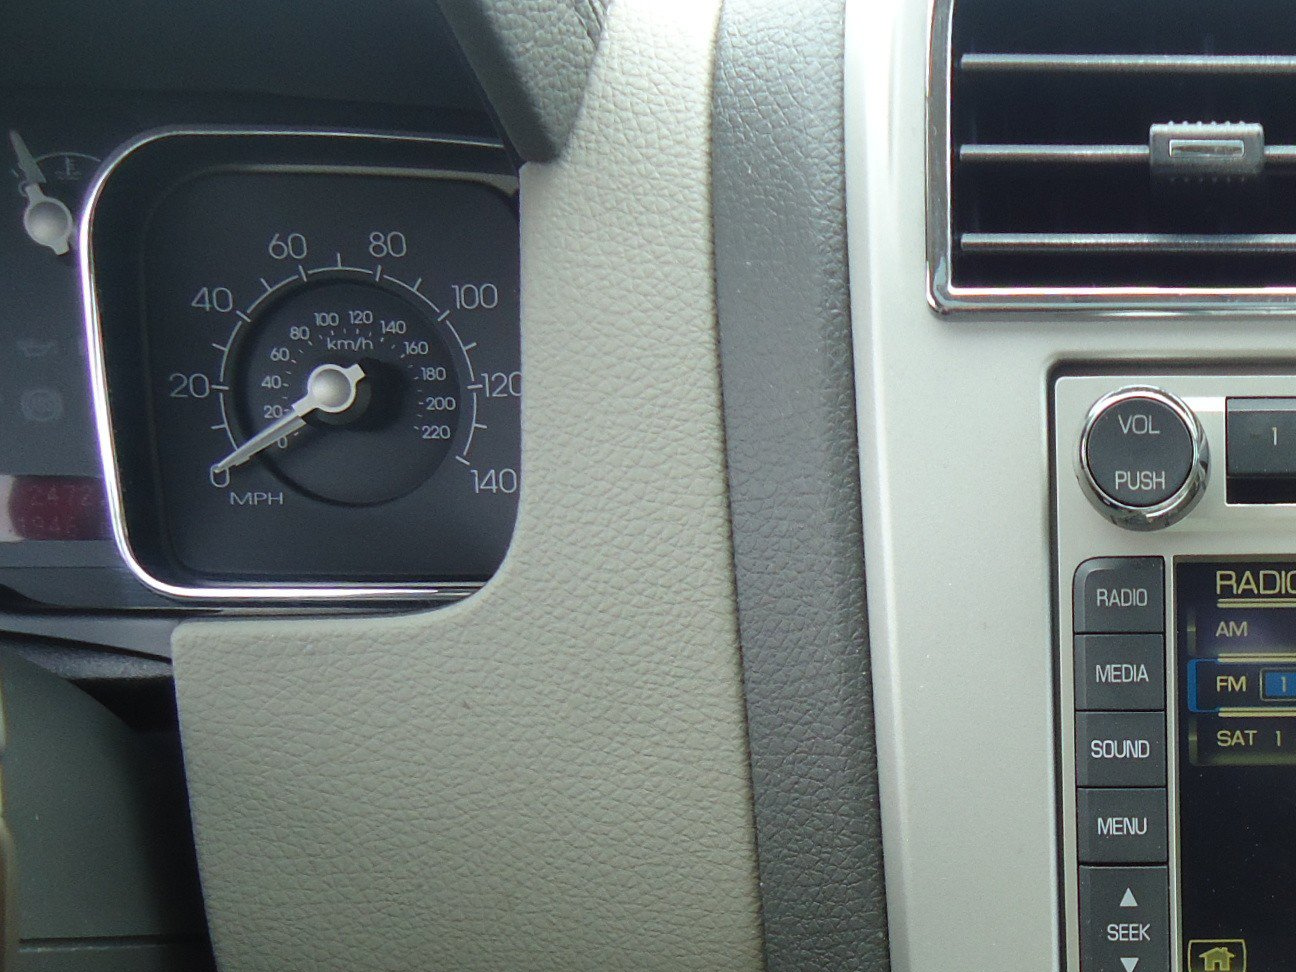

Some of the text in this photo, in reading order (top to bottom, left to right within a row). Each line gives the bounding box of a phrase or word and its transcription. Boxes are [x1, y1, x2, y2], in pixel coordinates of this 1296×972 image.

[268, 233, 308, 260] 60
[368, 231, 407, 258] 80
[191, 286, 234, 313] 40
[451, 283, 498, 310] 100
[313, 312, 339, 327] 100
[348, 310, 373, 325] 120
[290, 325, 310, 341] 80
[380, 319, 407, 335] 140
[327, 335, 374, 352] km/h
[402, 340, 429, 355] 160
[269, 346, 290, 362] 60
[261, 375, 282, 390] 40
[421, 366, 447, 381] 180
[169, 372, 210, 398] 20
[480, 371, 522, 398] 120
[263, 404, 283, 419] 20
[426, 396, 456, 411] 200
[421, 425, 451, 440] 220
[1117, 414, 1160, 435] VOL
[1269, 426, 1279, 447] 1
[470, 467, 517, 495] 140
[1114, 470, 1166, 491] PUSH
[230, 491, 284, 506] MPH
[1096, 588, 1148, 607] RADIO
[1215, 620, 1248, 637] AM
[1095, 663, 1149, 683] MEDIA
[1216, 675, 1247, 692] FM
[1280, 676, 1287, 693] 1
[1216, 729, 1258, 747] SAT
[1275, 730, 1281, 747] 1
[1090, 739, 1150, 759] SOUND
[1097, 817, 1148, 835] MENU
[1107, 923, 1151, 942] SEEK
